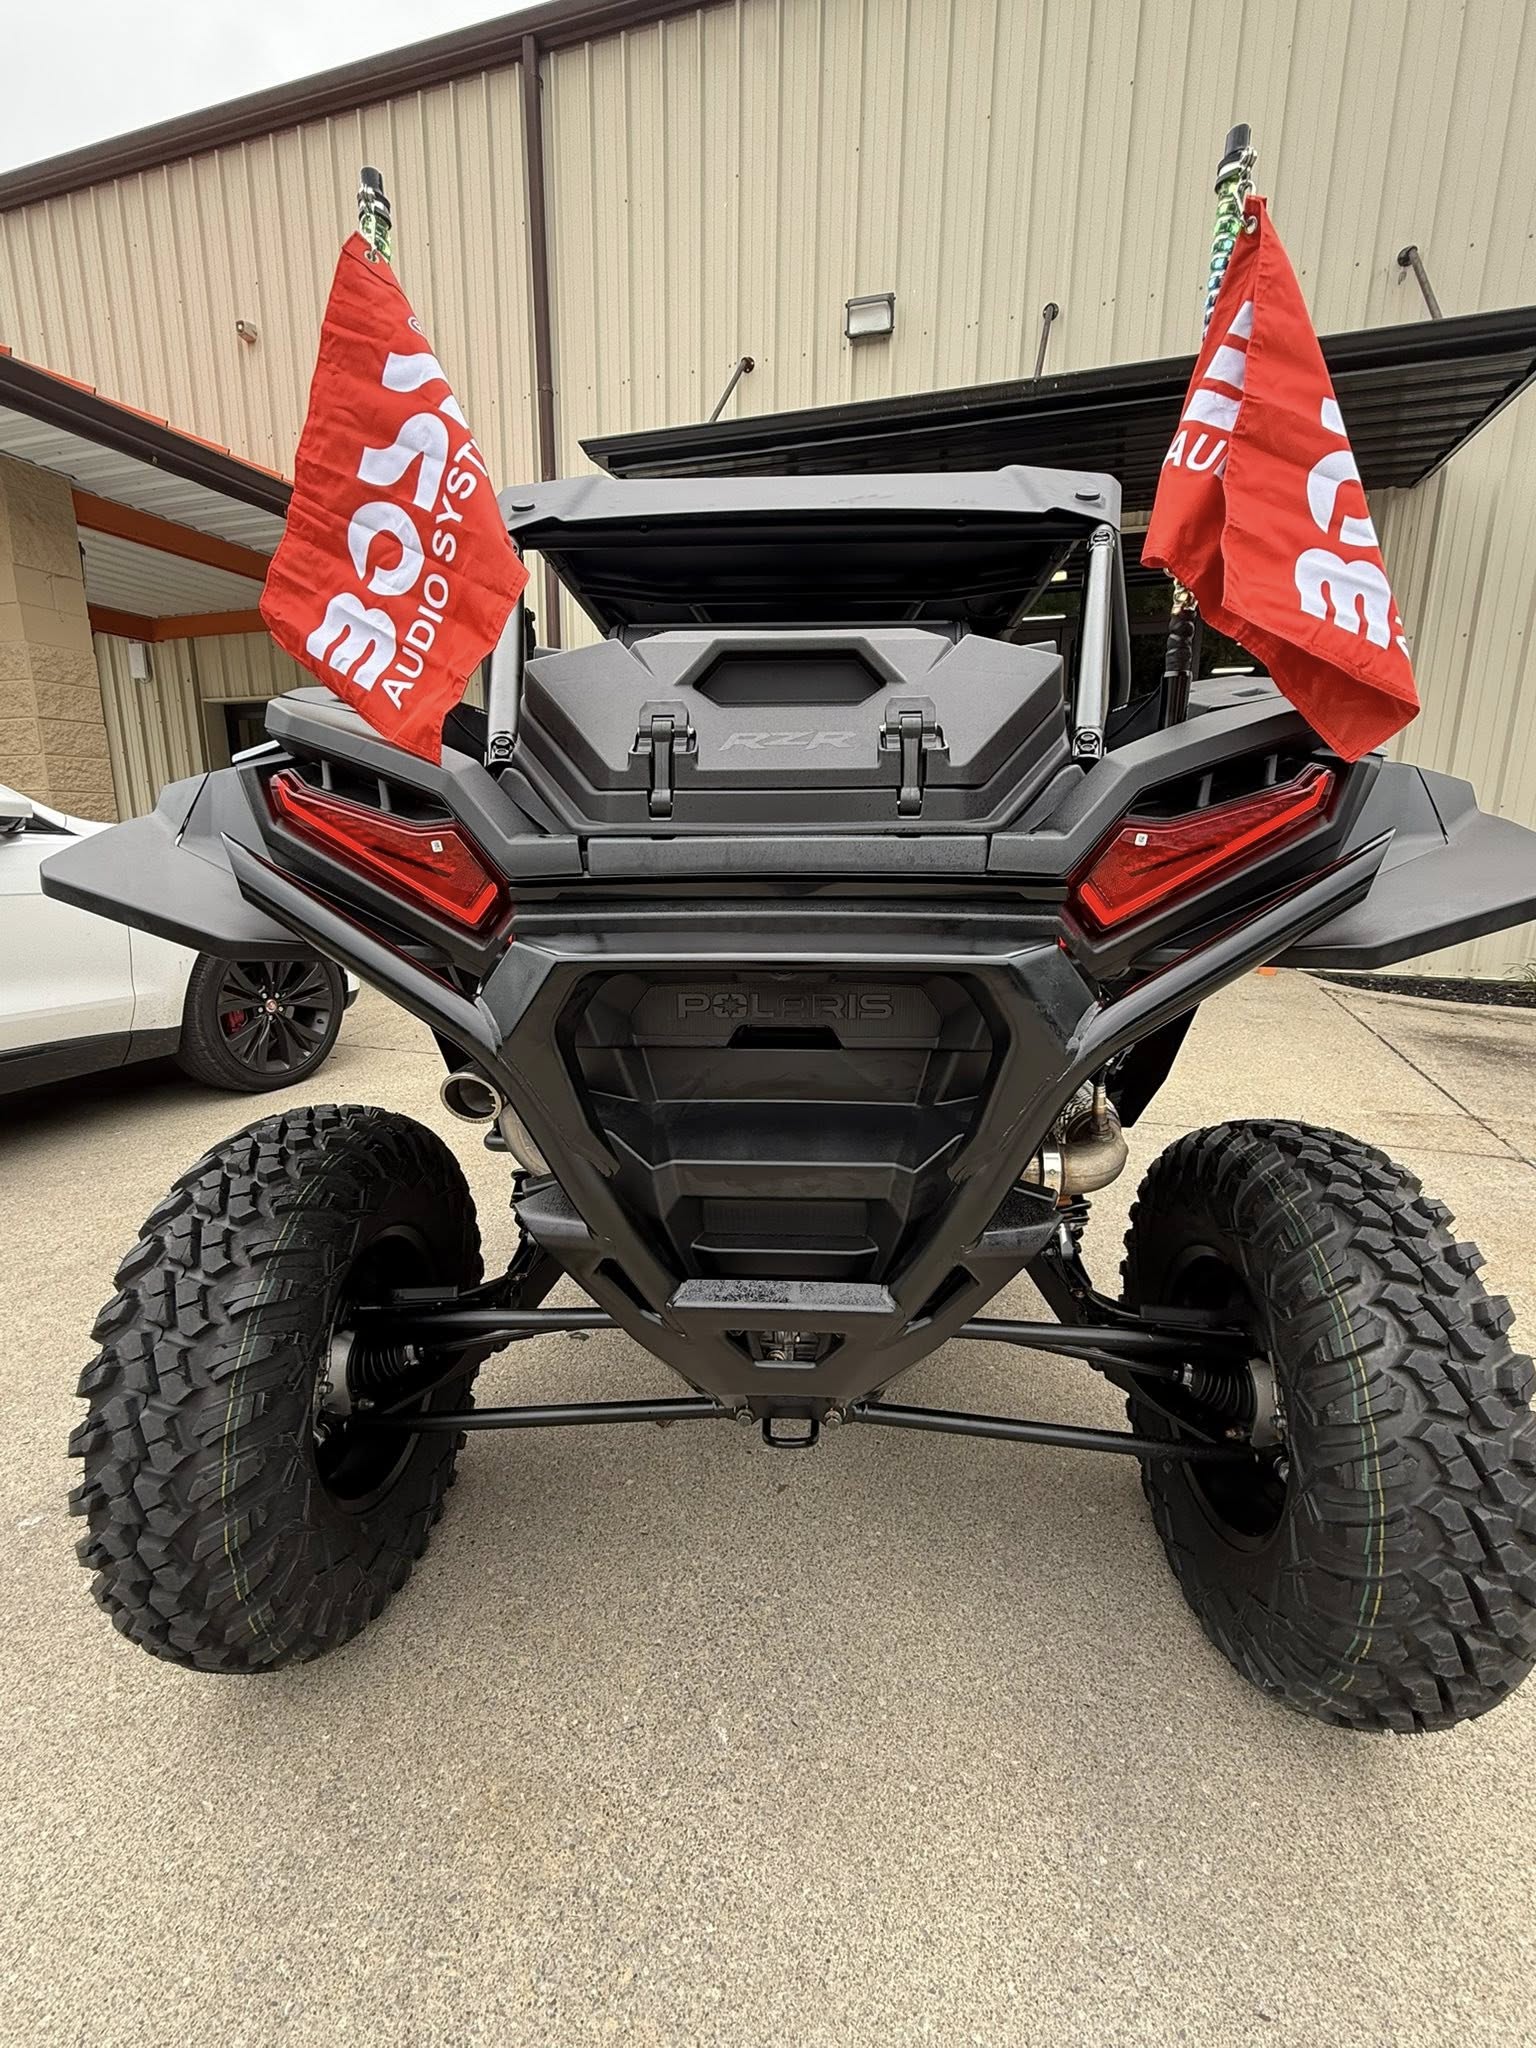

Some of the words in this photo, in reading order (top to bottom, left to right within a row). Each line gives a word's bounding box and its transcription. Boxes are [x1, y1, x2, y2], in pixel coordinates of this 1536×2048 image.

[381, 573, 449, 711] AUDIO
[431, 438, 488, 562] SYST
[1295, 397, 1391, 650] BO
[719, 728, 857, 751] RZR
[677, 993, 893, 1020] POLARIS
